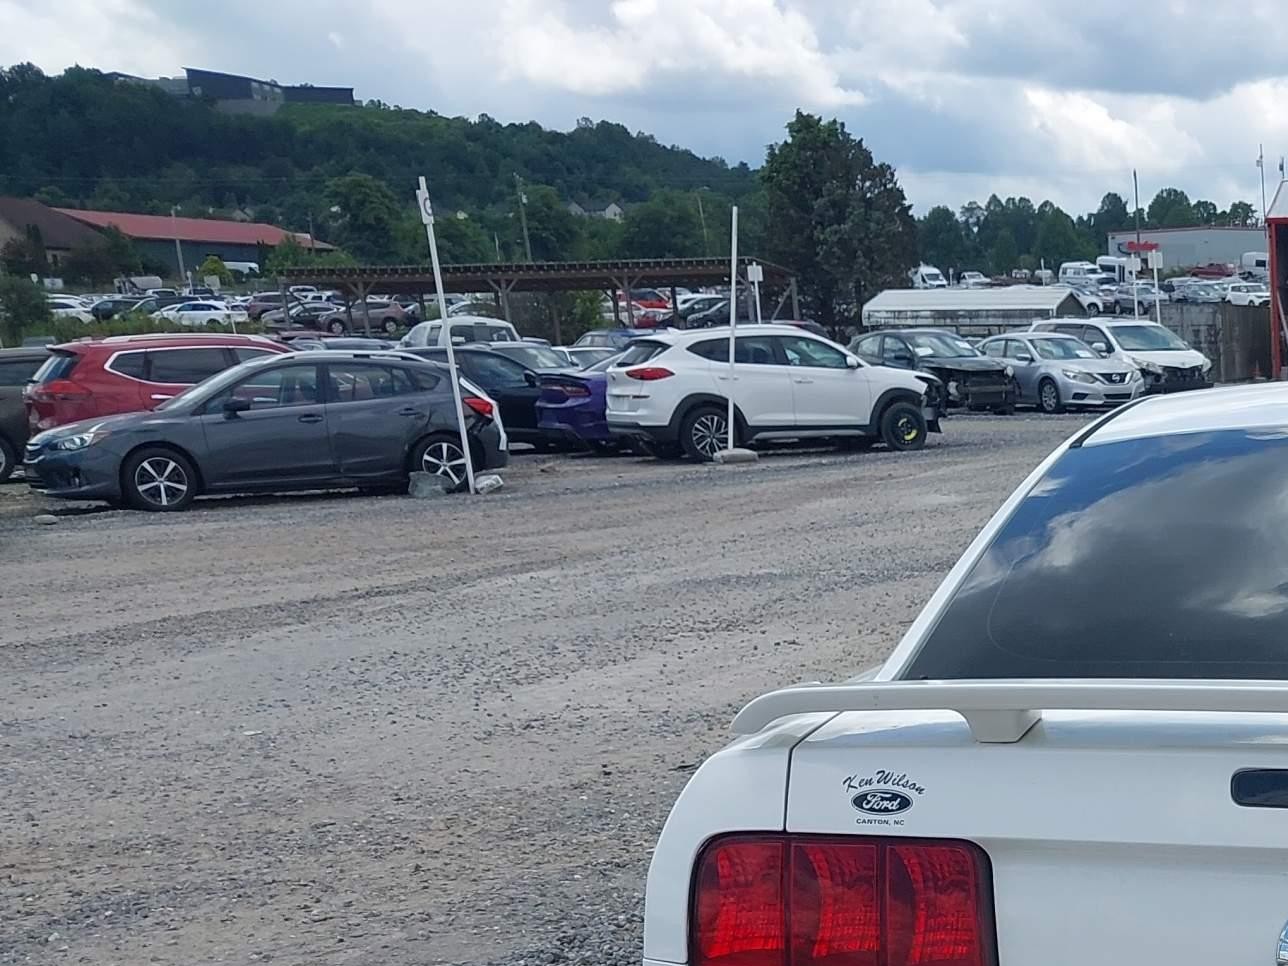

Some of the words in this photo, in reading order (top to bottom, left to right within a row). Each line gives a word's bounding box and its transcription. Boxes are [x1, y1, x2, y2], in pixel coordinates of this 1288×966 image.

[842, 774, 874, 792] Ken
[876, 770, 926, 795] Wilson
[862, 793, 901, 810] Ford
[856, 818, 891, 826] CANTON,
